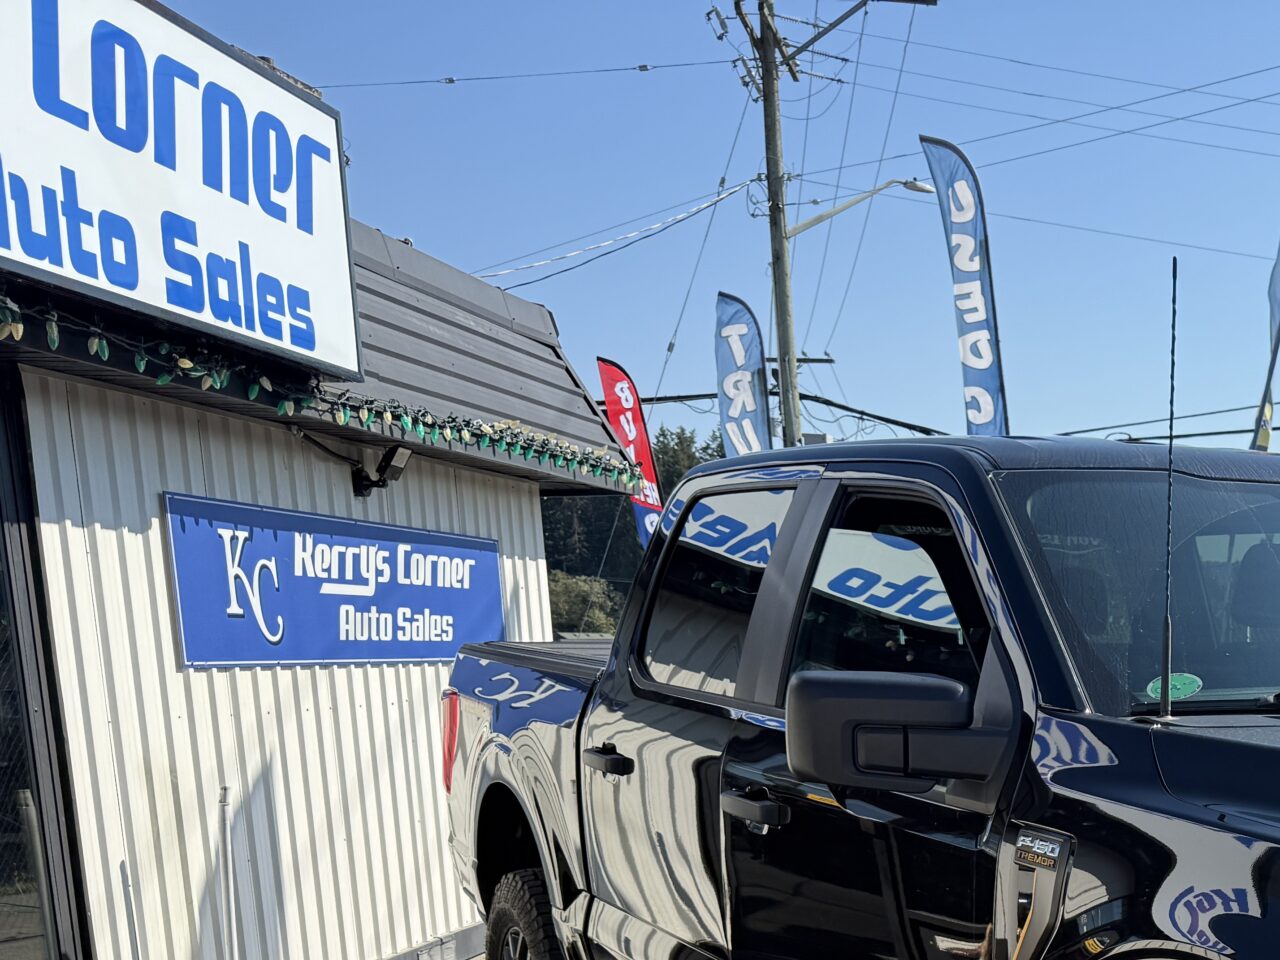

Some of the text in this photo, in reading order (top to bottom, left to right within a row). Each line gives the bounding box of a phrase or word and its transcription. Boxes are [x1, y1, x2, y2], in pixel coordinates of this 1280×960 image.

[0, 155, 316, 352] uto Sales
[397, 543, 475, 589] Corner
[339, 604, 453, 642] Auto Sales
[1016, 850, 1056, 868] TREMOR
